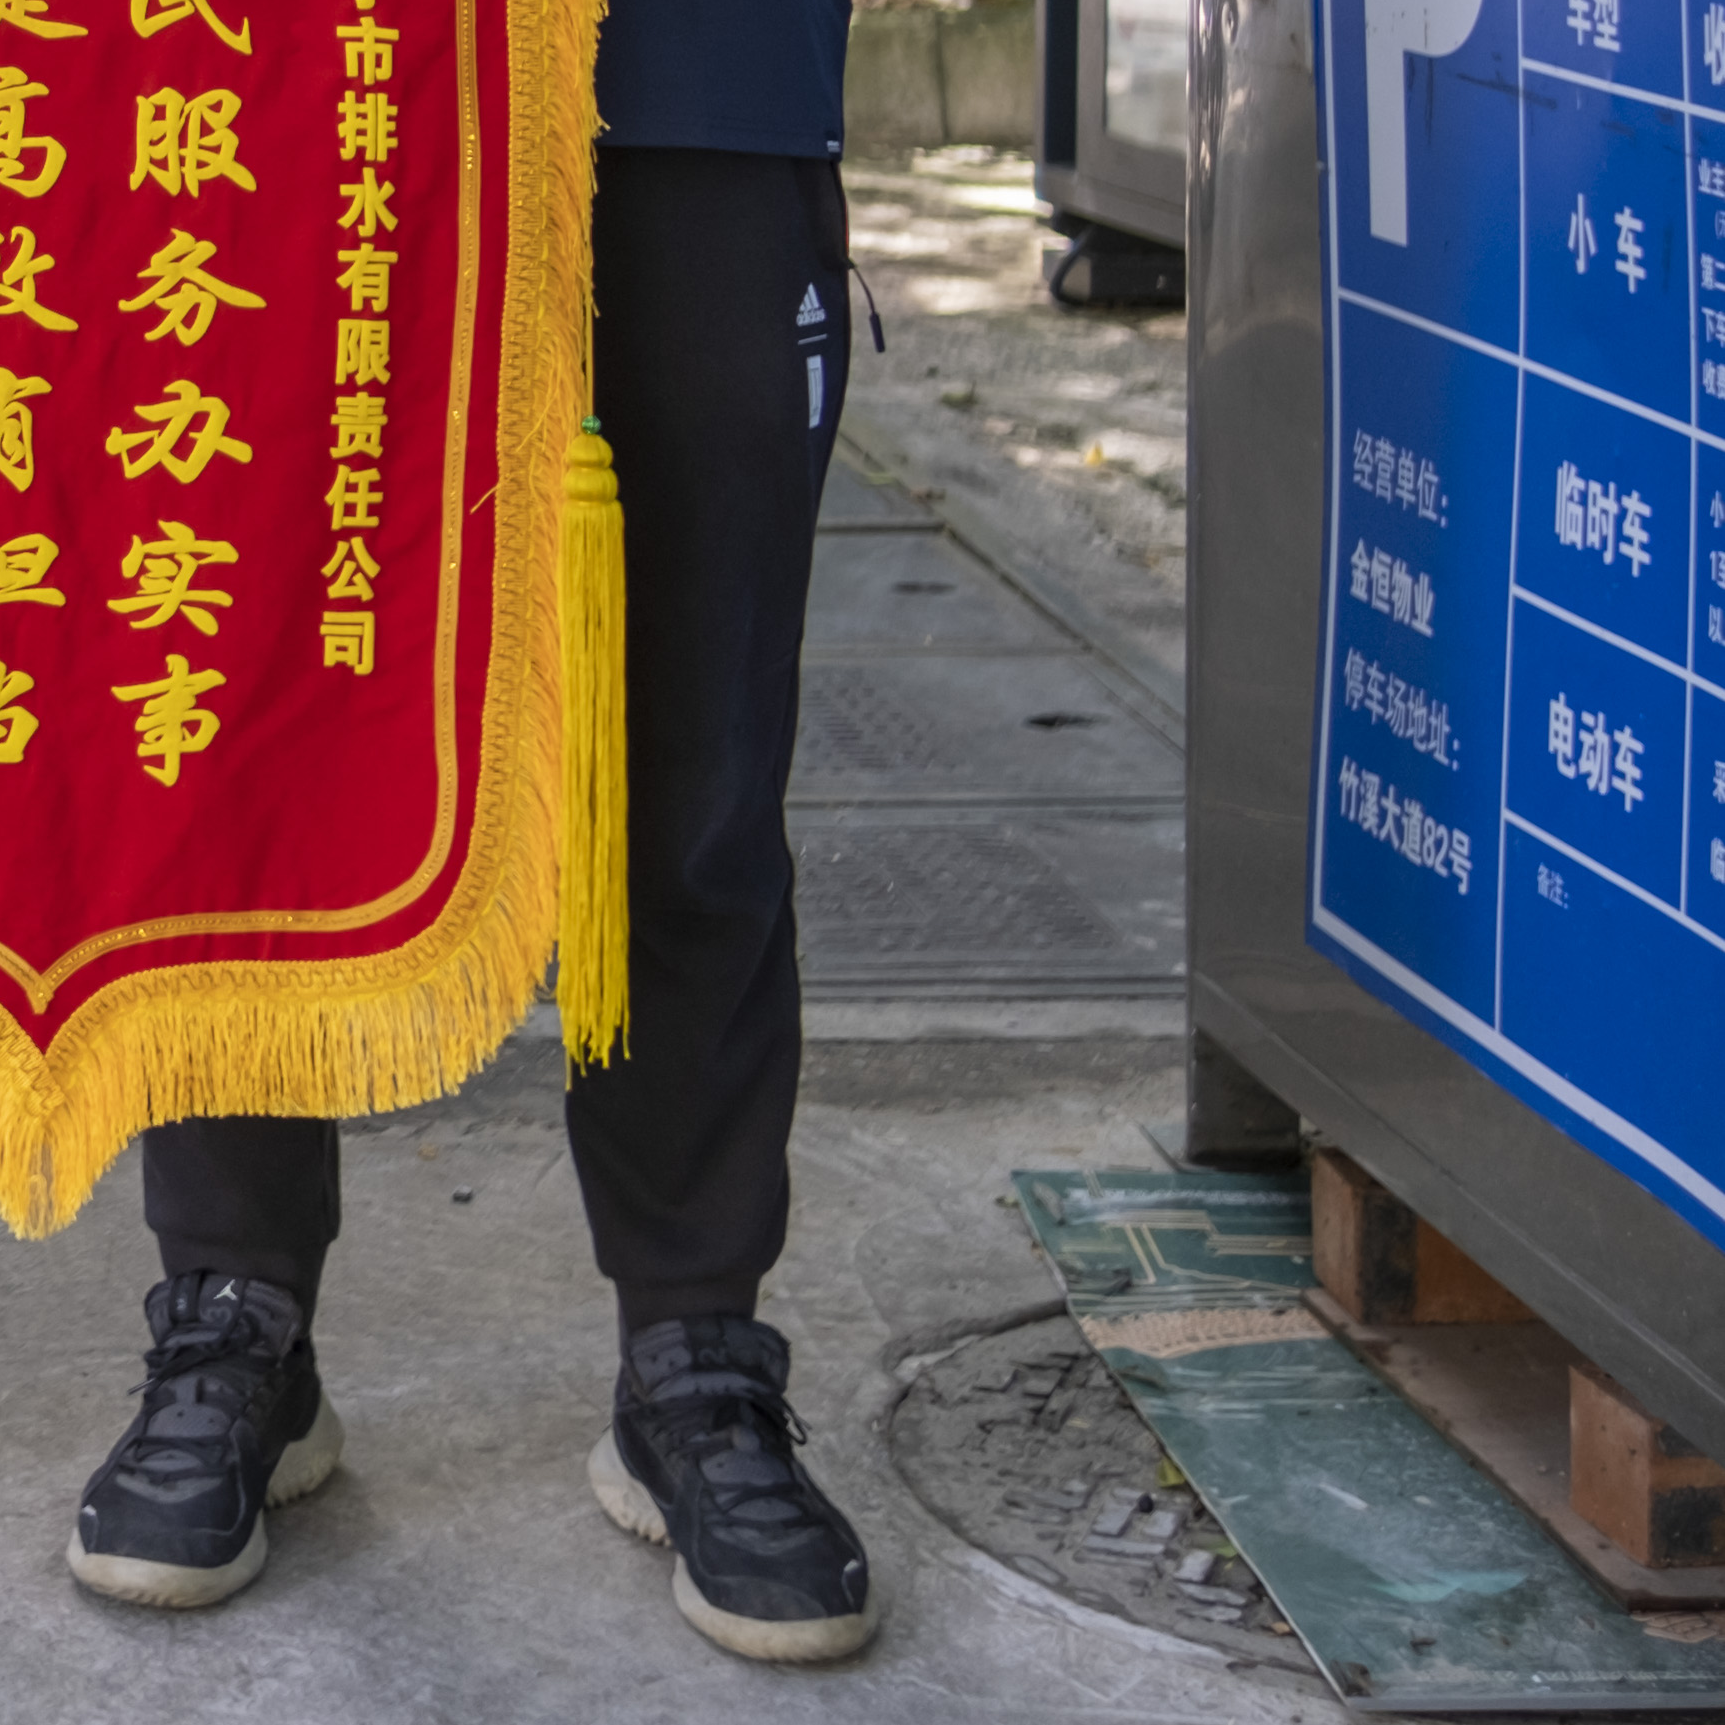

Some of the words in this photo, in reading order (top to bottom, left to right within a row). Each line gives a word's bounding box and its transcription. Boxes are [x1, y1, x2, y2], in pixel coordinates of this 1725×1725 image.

[1554, 459, 1653, 578] 临时车
[1350, 538, 1435, 638] 金恒物业
[1548, 691, 1645, 813] 电动车
[1338, 755, 1473, 896] 竹溪大道82号
